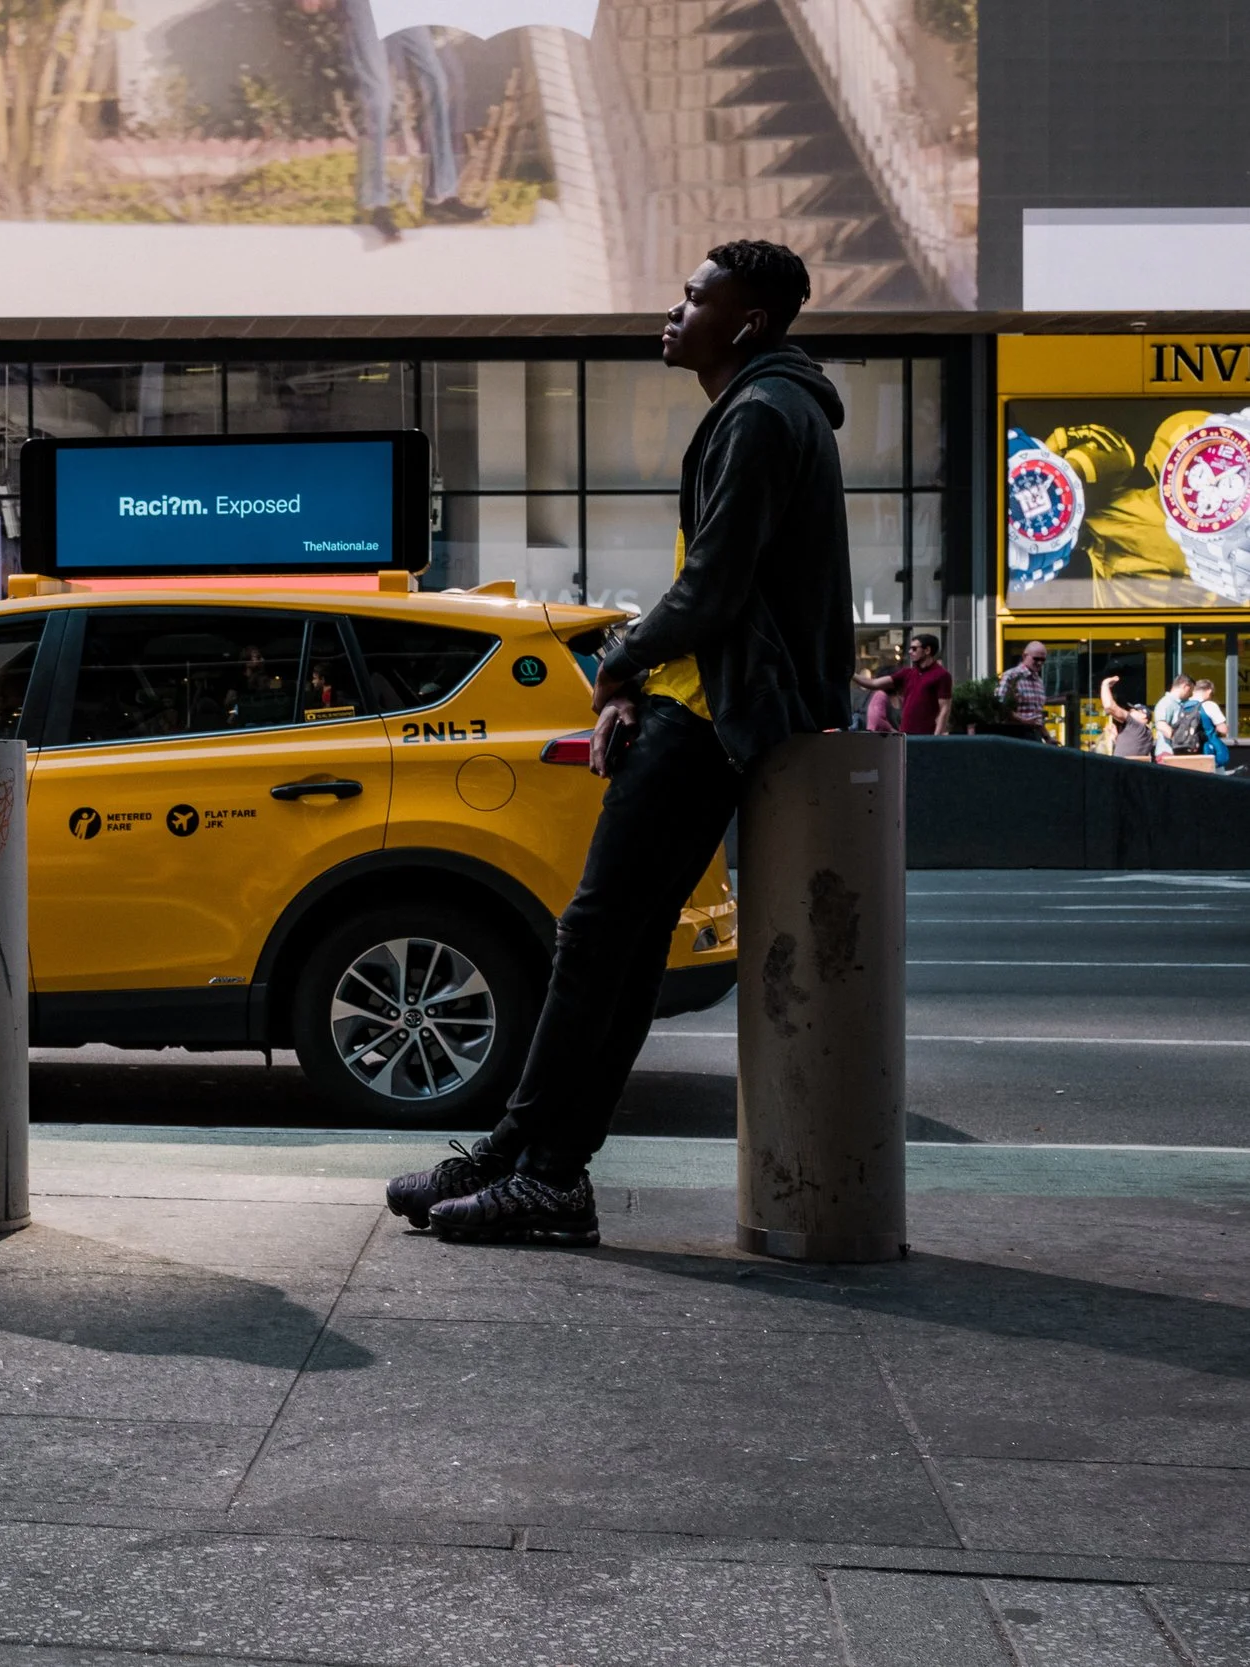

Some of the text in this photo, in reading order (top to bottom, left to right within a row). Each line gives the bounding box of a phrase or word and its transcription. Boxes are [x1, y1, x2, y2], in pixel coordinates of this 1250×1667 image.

[119, 494, 301, 518] Raci?m. Exposed
[303, 540, 379, 552] TheNational.ae
[402, 719, 487, 744] 2N63
[107, 813, 152, 822] METERED
[205, 810, 257, 819] FLAT FARE
[107, 823, 132, 832] FARE
[205, 820, 224, 829] JFK
